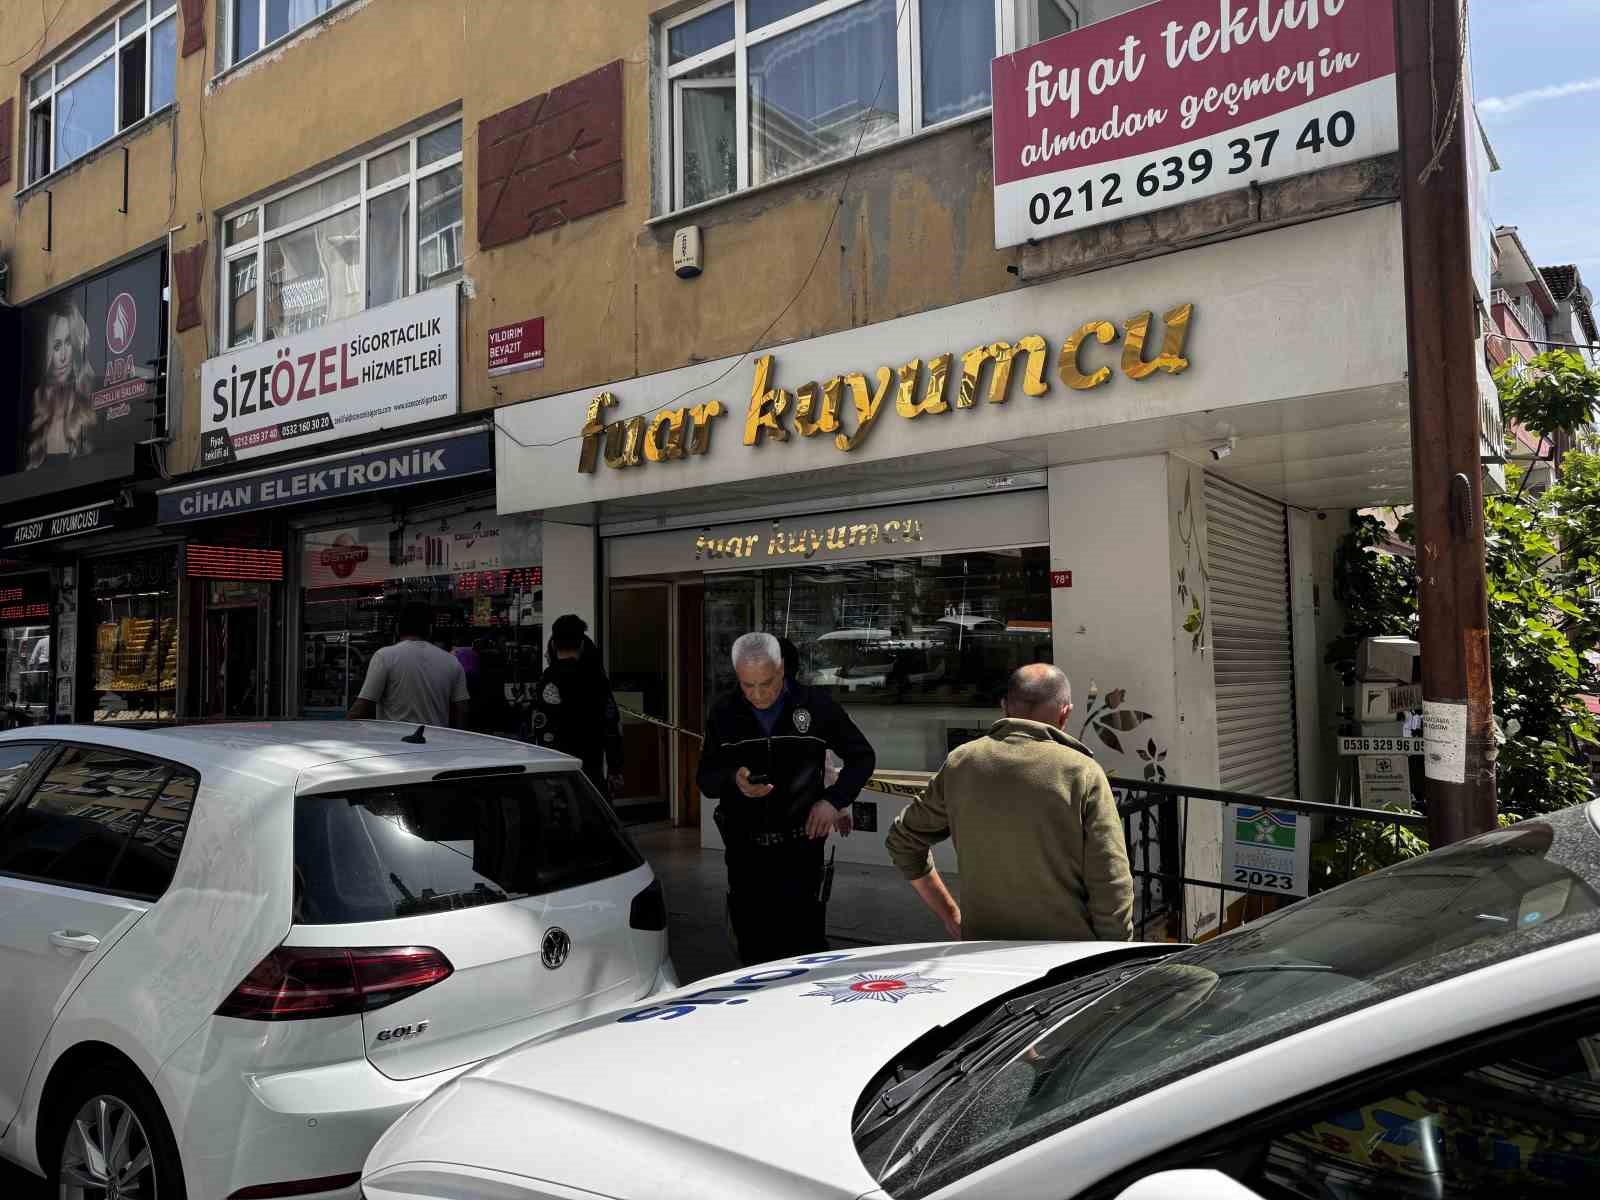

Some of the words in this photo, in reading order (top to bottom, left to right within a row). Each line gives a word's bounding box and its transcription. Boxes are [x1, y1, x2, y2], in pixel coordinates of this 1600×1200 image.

[1026, 34, 1145, 118] fiyat
[1020, 105, 1168, 166] almadan
[1180, 48, 1361, 128] geçmeyin
[1029, 172, 1122, 224] 0212
[1136, 148, 1213, 197] 639
[1228, 129, 1280, 174] 37
[1296, 110, 1355, 154] 40
[350, 317, 441, 357] SİGORTACILIK
[490, 327, 523, 343] YILDIRIM
[490, 341, 521, 359] BEYAZIT
[362, 344, 442, 383] HİZMETLERİ
[578, 390, 728, 474] fuar
[743, 304, 1194, 452] kuyumcu
[179, 486, 252, 516] CİHAN
[259, 449, 447, 501] ELEKTRONİK
[14, 522, 44, 542] ATASOY
[51, 509, 101, 536] KUYUMCUSU
[1344, 739, 1369, 750] 0536
[1373, 739, 1393, 750] 329
[1396, 740, 1410, 750] 96
[1234, 869, 1293, 889] 2023
[377, 1021, 428, 1041] GOLF
